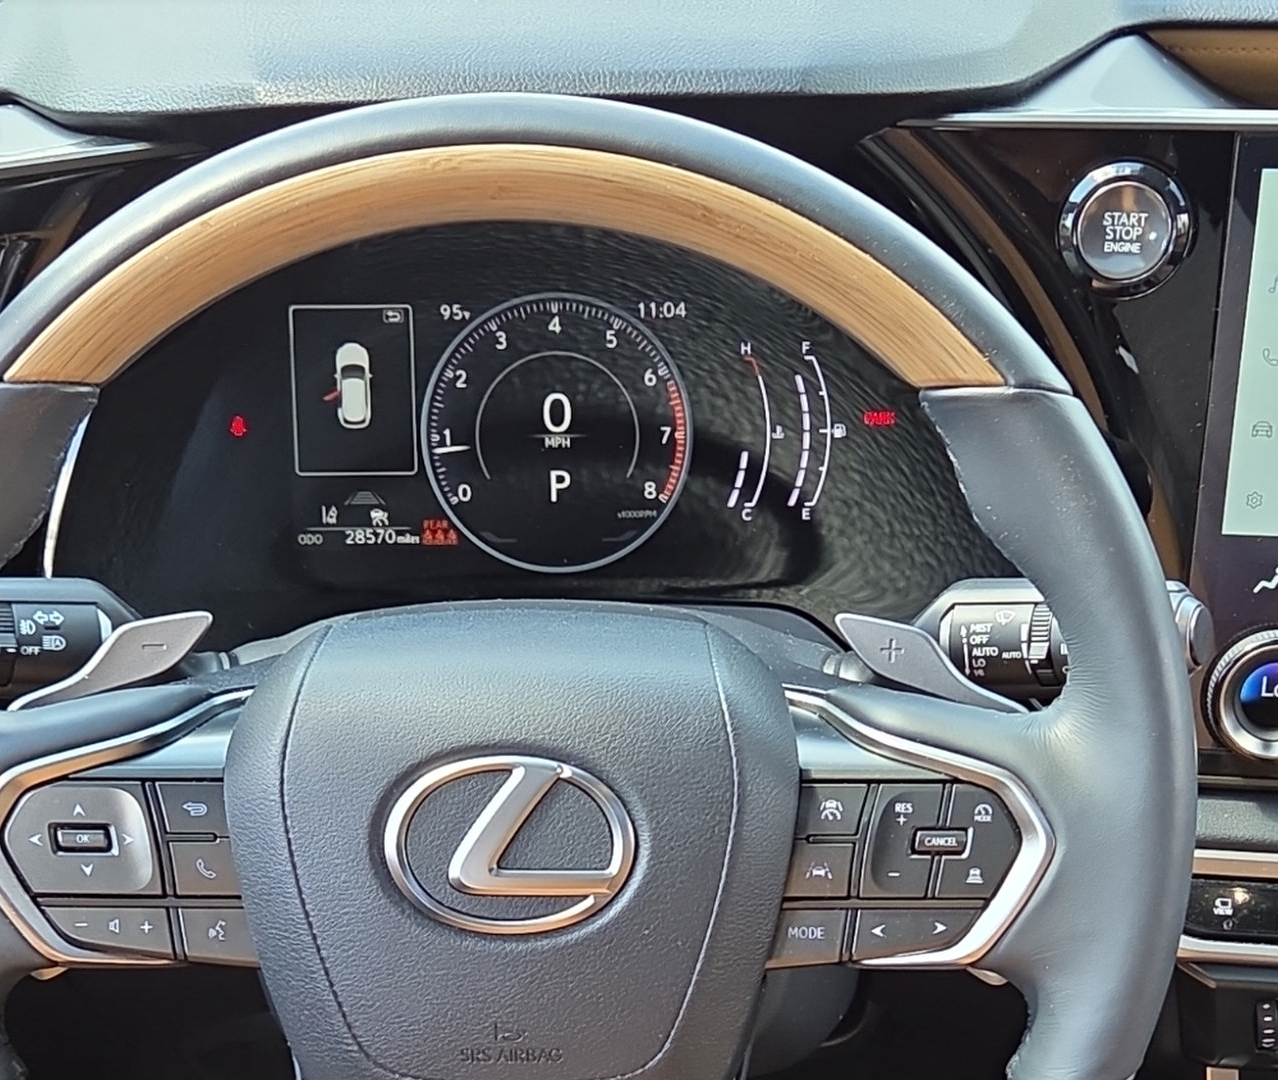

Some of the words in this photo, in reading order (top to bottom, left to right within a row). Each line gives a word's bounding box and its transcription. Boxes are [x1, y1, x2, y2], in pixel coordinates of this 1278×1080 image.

[1103, 212, 1149, 227] START
[1105, 226, 1143, 240] STOP
[1104, 241, 1141, 253] ENGINE
[638, 302, 687, 319] 11:04
[548, 315, 561, 334] 4
[495, 331, 507, 350] 3
[606, 330, 617, 348] 5
[741, 342, 751, 355] H
[802, 341, 811, 354] F
[455, 370, 467, 388] 2
[644, 369, 657, 386] 6
[543, 393, 572, 433] 0
[443, 429, 451, 447] 1
[660, 427, 671, 445] 7
[544, 437, 571, 449] MPH
[457, 484, 472, 502] 0
[549, 470, 571, 503] P
[644, 481, 657, 499] 8
[742, 509, 752, 521] C
[802, 508, 811, 520] E
[298, 533, 323, 545] ODO
[345, 529, 396, 545] 28570
[970, 623, 993, 634] MIST
[970, 634, 990, 645] OFF
[21, 646, 41, 656] OFF
[972, 646, 999, 657] AUTO
[1002, 651, 1022, 659] AUTO
[972, 658, 986, 668] LO
[895, 803, 913, 814] RES
[76, 834, 90, 843] OK
[924, 837, 959, 847] CANCEL
[788, 927, 825, 940] MODE
[461, 1048, 491, 1063] SRS
[494, 1048, 563, 1063] AIRBAG
